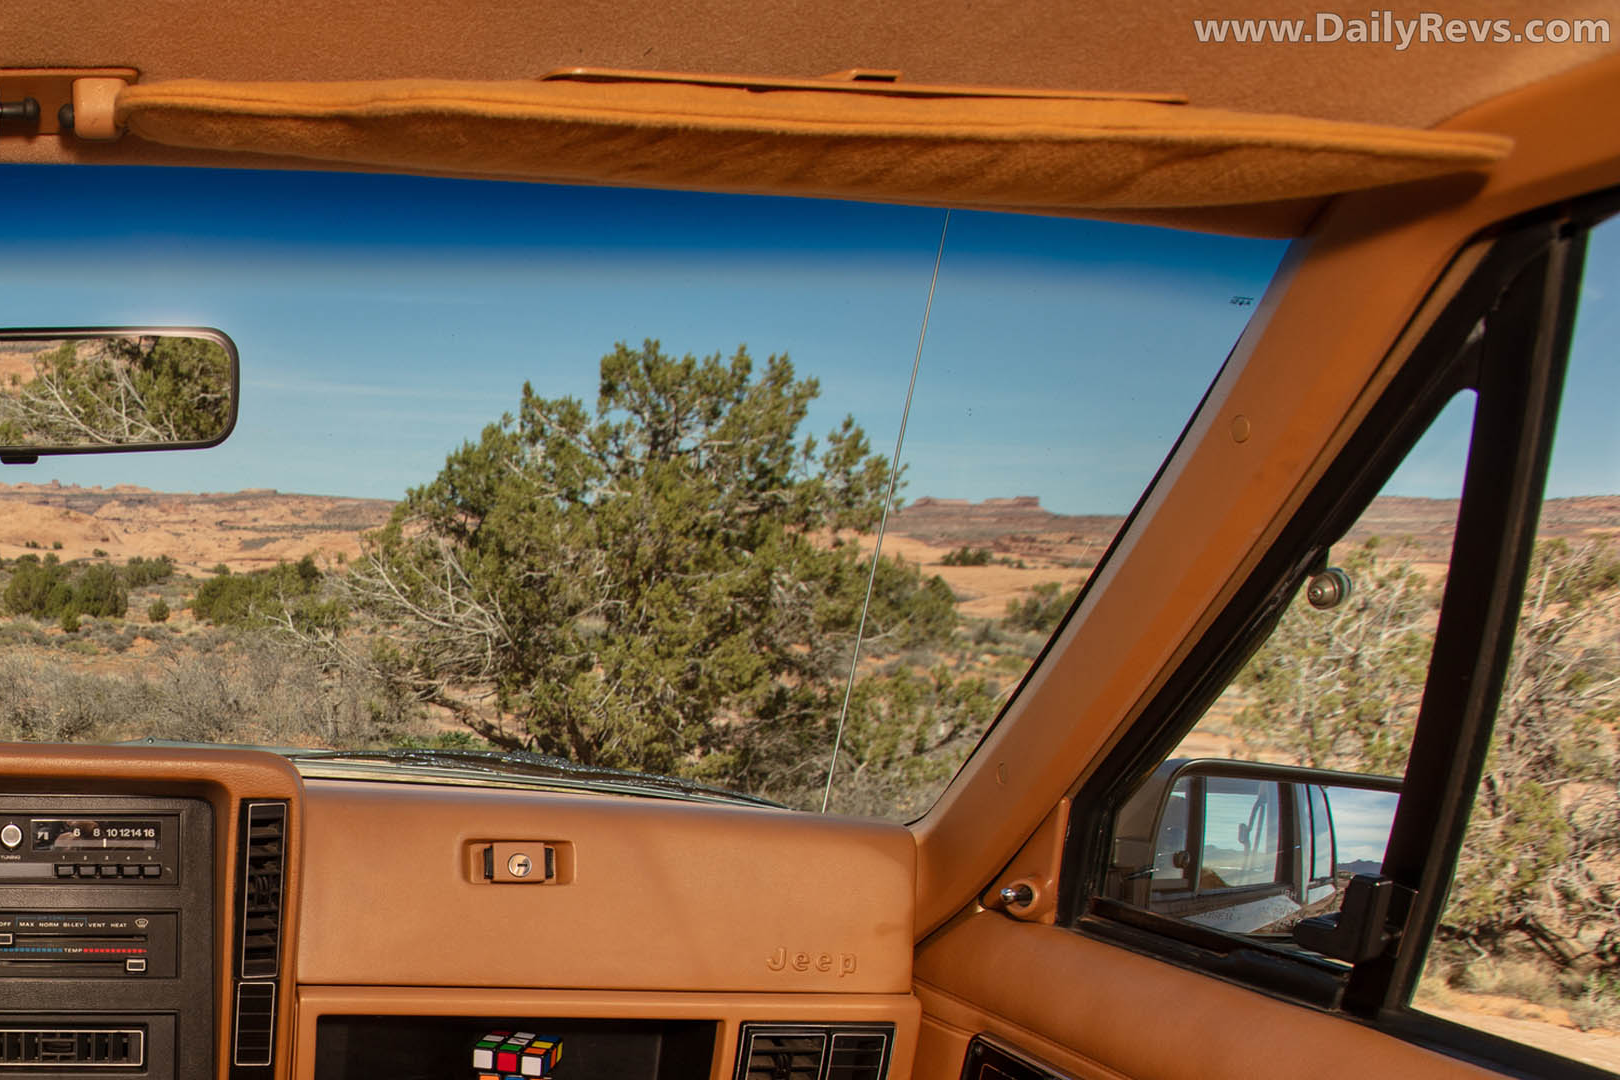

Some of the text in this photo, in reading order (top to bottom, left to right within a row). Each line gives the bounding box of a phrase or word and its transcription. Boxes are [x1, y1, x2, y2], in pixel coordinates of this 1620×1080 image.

[73, 828, 155, 837] 6 8 10 12 14 16
[766, 946, 858, 977] Jeep
